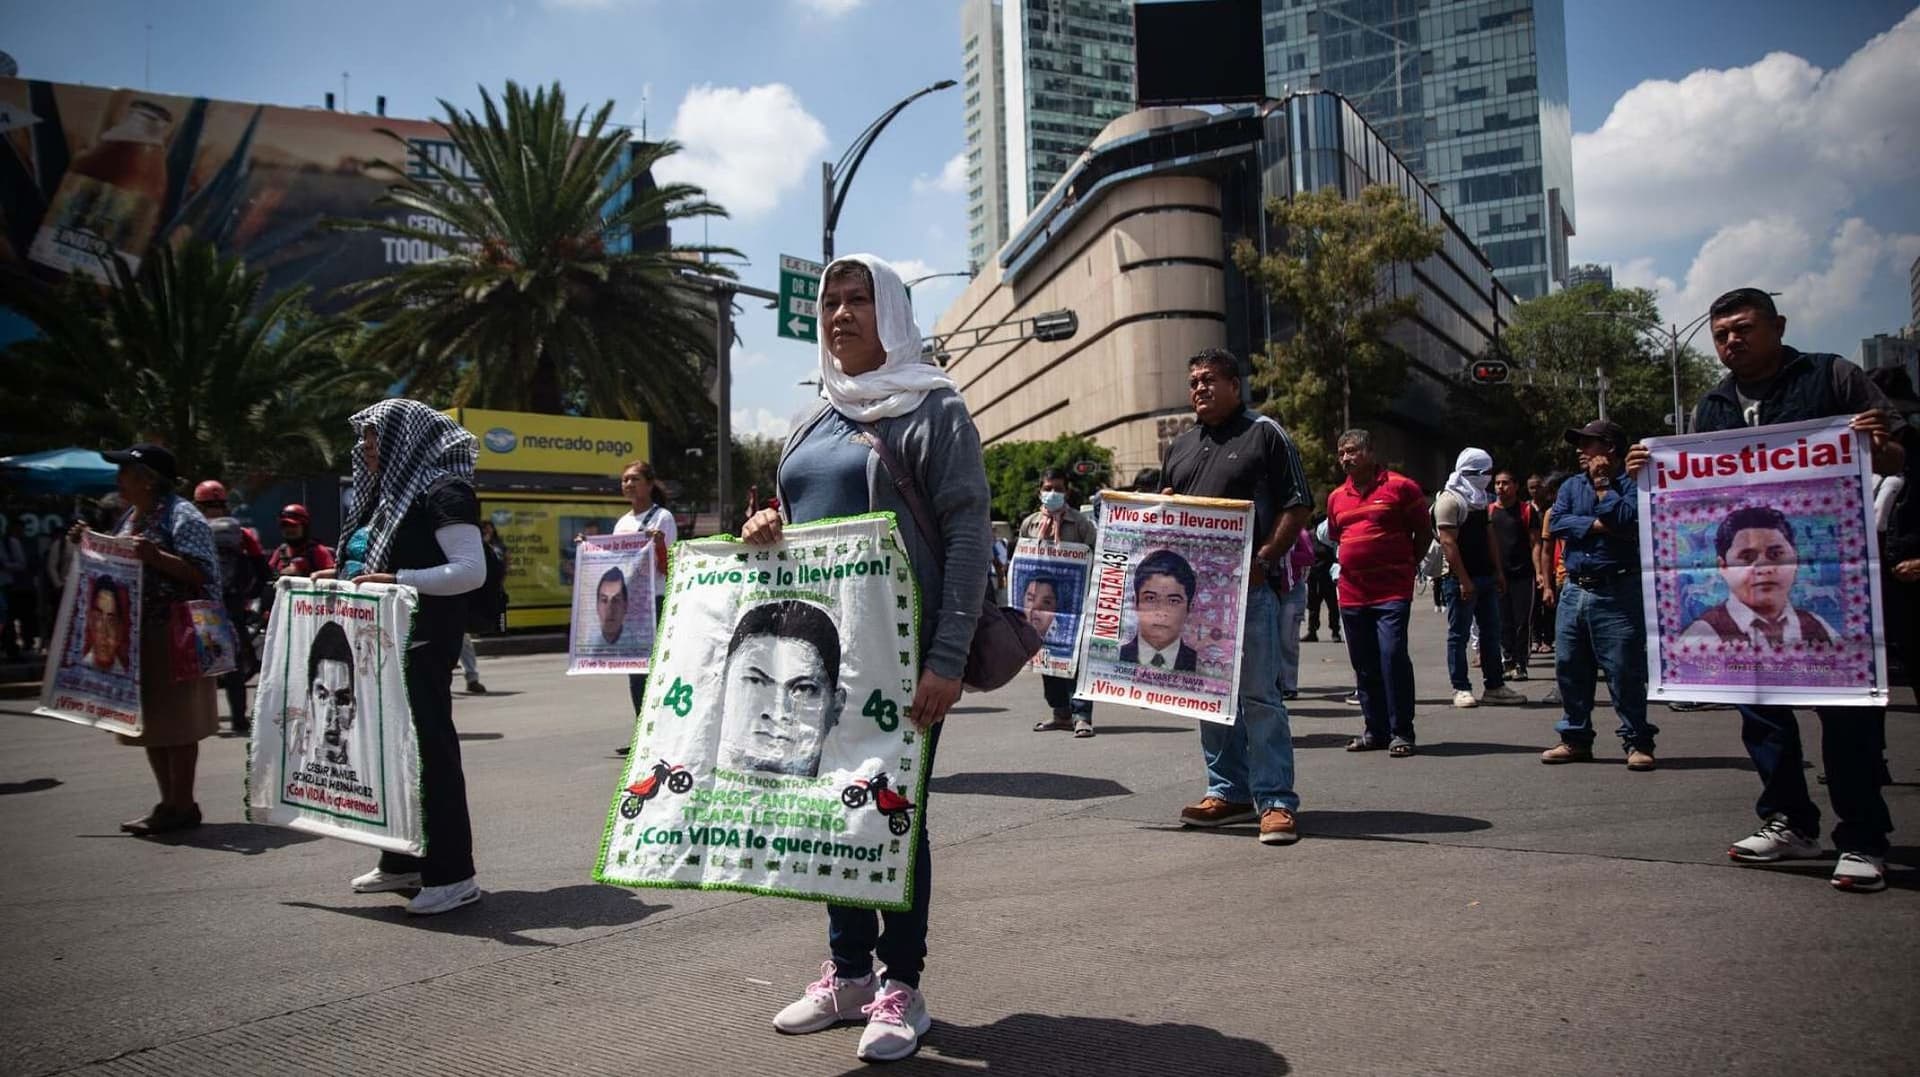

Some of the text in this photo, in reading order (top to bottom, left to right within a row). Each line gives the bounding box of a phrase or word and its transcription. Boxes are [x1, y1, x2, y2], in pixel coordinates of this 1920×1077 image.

[523, 434, 633, 457] mercado pago
[1656, 434, 1852, 489] ¡Justicia!
[1109, 506, 1139, 523] ¡Vivo
[1142, 511, 1158, 524] se
[1162, 510, 1175, 525] lo
[1179, 511, 1244, 532] llevaron!
[686, 556, 892, 590] ¡Vivo se lo llevaron!
[1098, 567, 1126, 612] FALTAN
[1094, 611, 1120, 638] NOS
[663, 676, 694, 718] 43
[862, 688, 899, 732] 43
[1091, 680, 1126, 697] ¡Vivo
[1130, 685, 1142, 699] lo
[1146, 692, 1222, 713] queremos!
[635, 826, 884, 863] ¡Con VIDA lo queremos!
